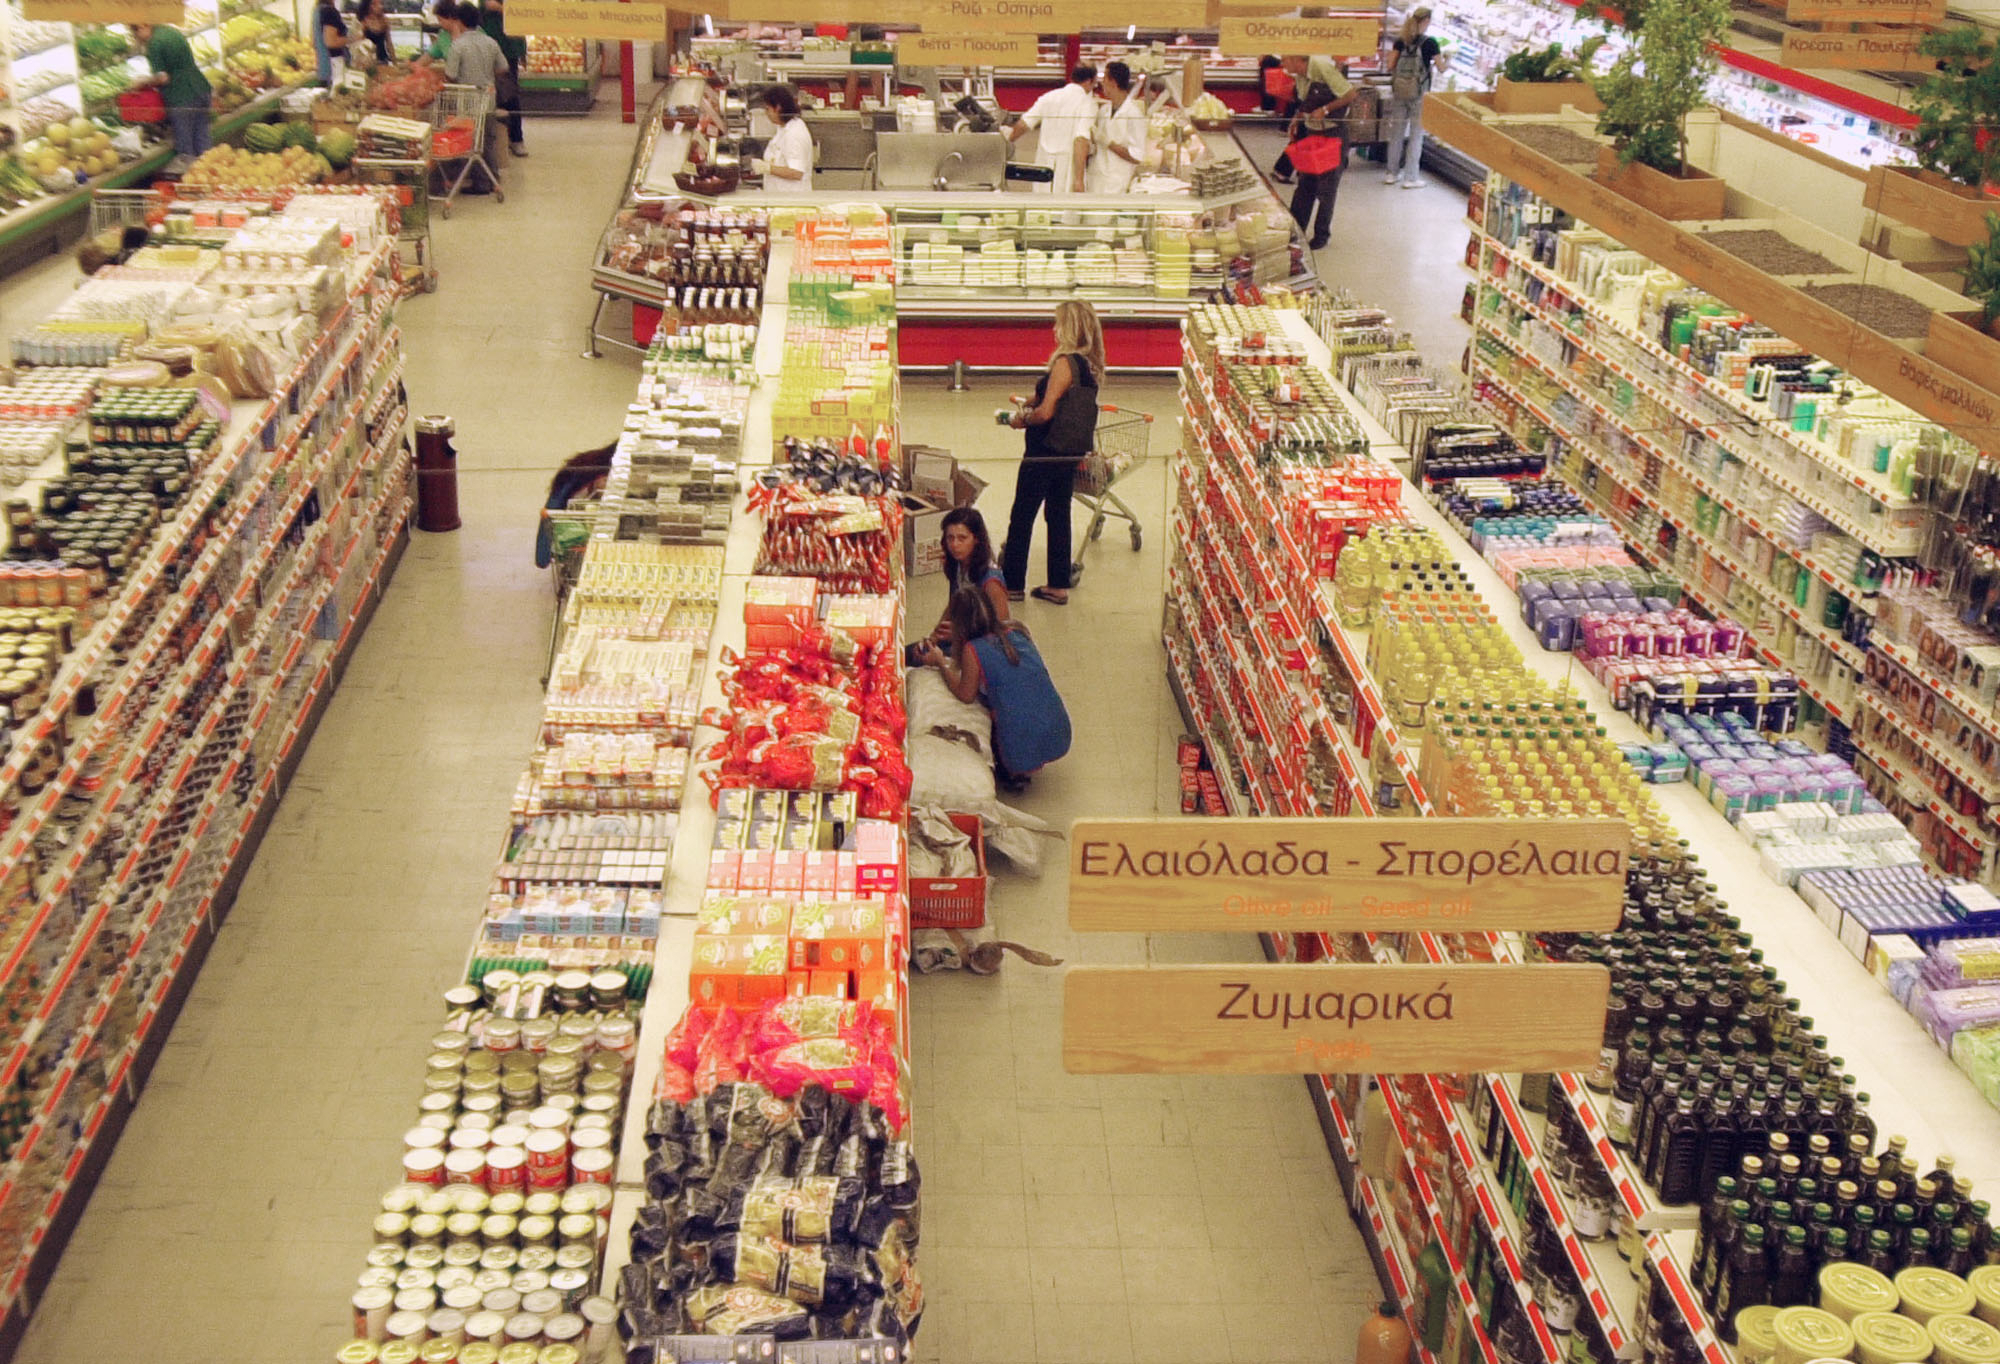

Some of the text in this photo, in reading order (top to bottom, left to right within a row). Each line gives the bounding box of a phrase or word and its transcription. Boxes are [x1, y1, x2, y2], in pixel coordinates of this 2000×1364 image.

[1081, 840, 1329, 876] Ελαιόλαδα
[1376, 840, 1622, 885] Σπορέλαια
[1222, 894, 1293, 917] Olive
[1301, 896, 1333, 916] oil
[1360, 896, 1431, 918] Seed
[1440, 898, 1473, 918] oil
[1217, 982, 1454, 1029] Ζυμαρικά
